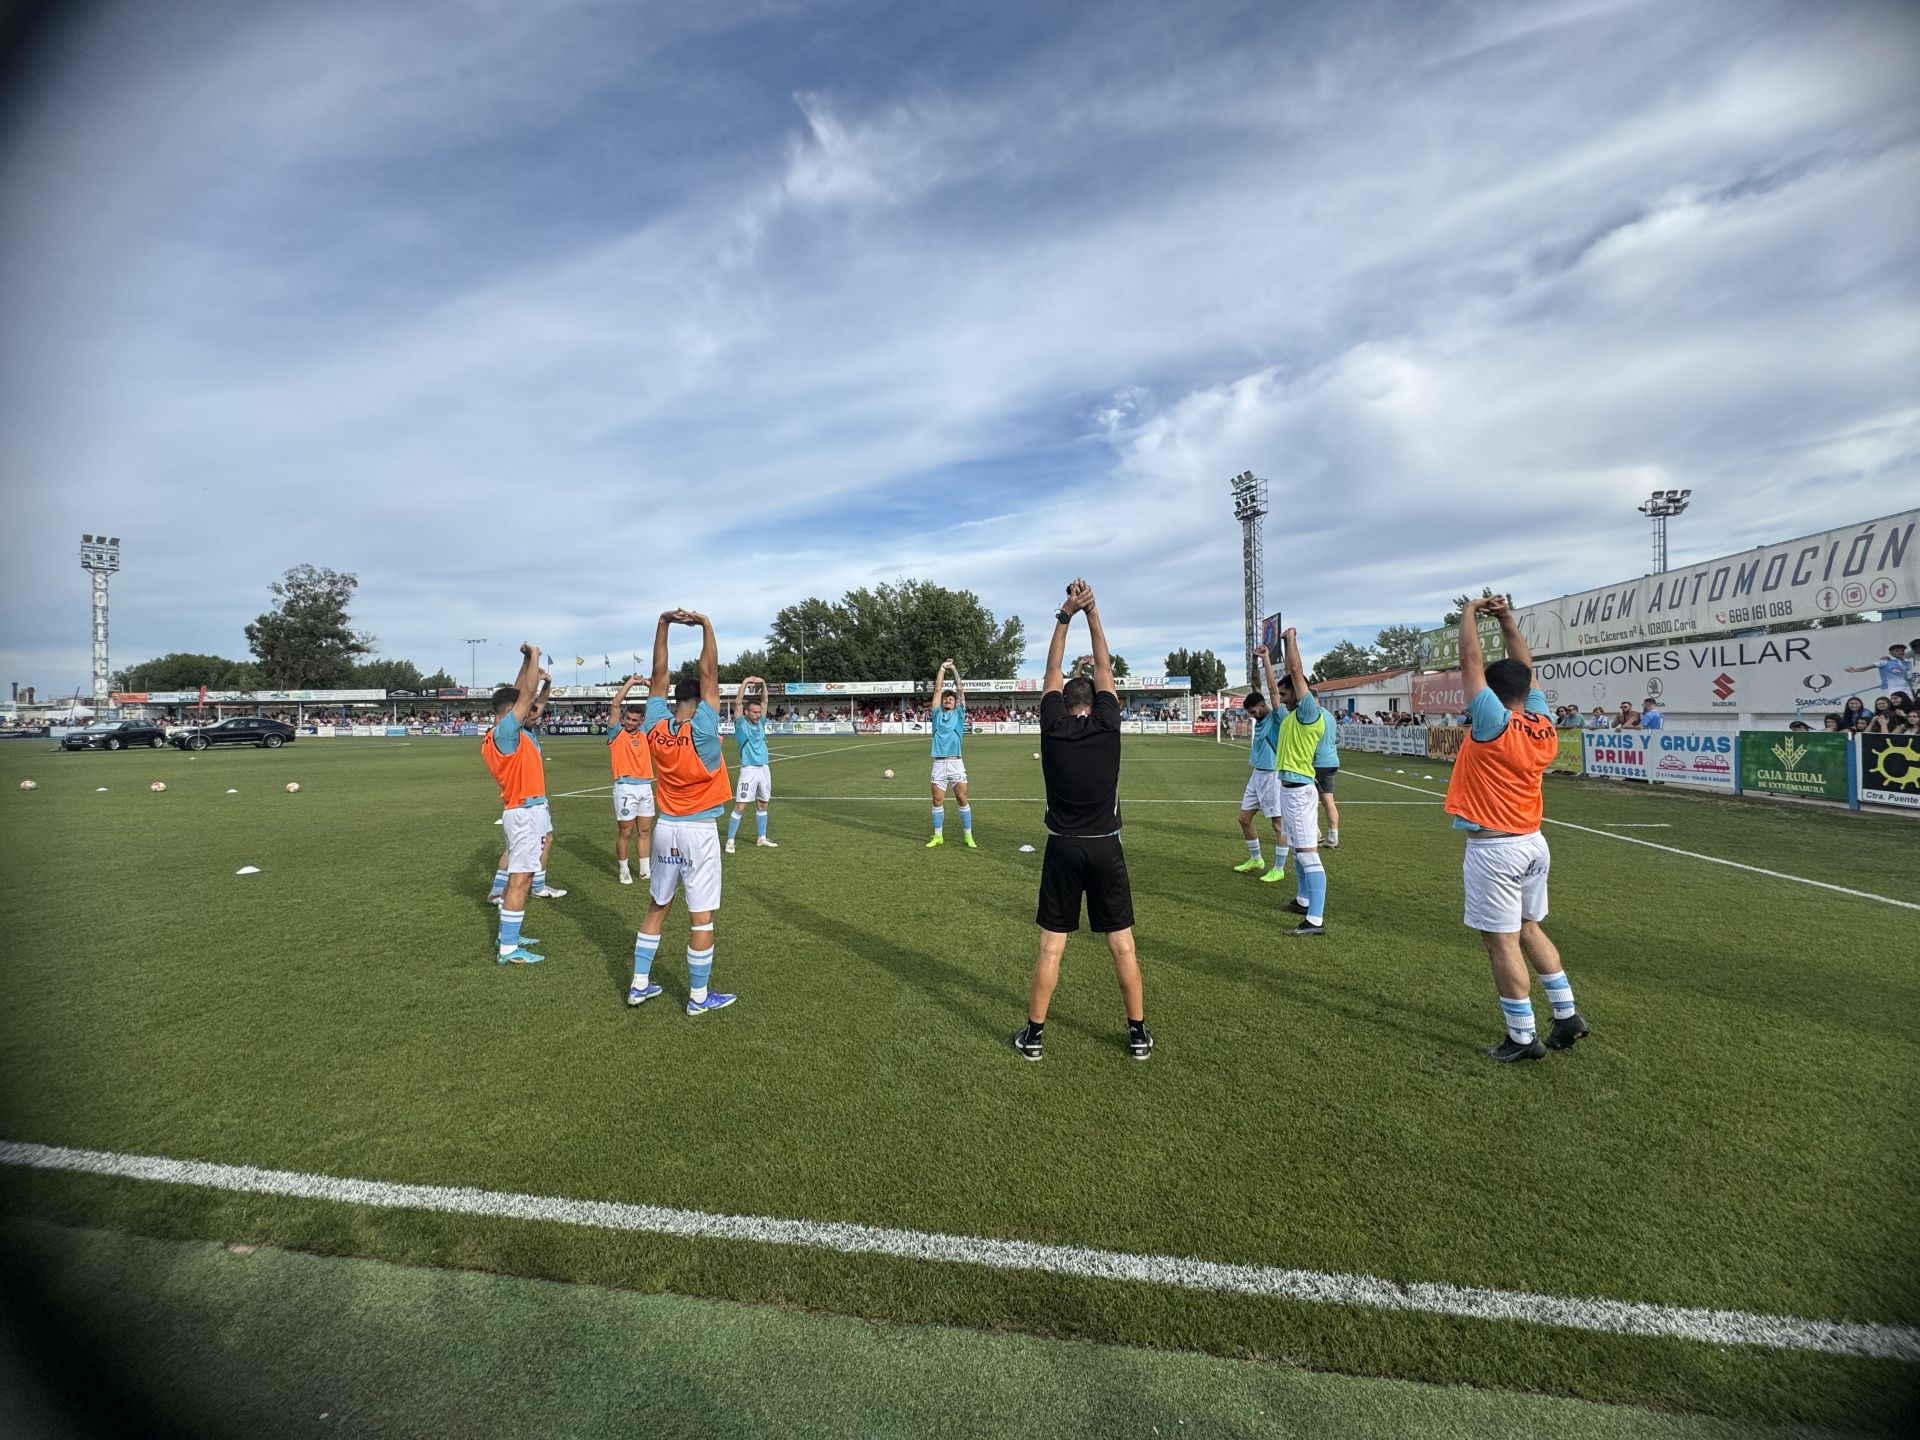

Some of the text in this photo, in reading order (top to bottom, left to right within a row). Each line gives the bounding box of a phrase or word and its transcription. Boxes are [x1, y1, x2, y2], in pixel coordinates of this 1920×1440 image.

[1570, 523, 1916, 627] JMGM AUTOMOCIÓN
[1600, 630, 1628, 643] Cáceres
[1648, 621, 1672, 636] 10800
[1674, 618, 1697, 632] Coria
[1533, 638, 1812, 680] TOMOCIONES VILLAR
[1586, 733, 1732, 754] TAXIS Y GRÚAS
[1595, 749, 1644, 766] PRIMI
[1757, 769, 1826, 784] CAJA RURAL
[741, 782, 749, 791] 10
[1769, 781, 1825, 794] EXTREMADURA
[622, 797, 628, 807] 7
[1866, 791, 1918, 805] Ctra. Puente
